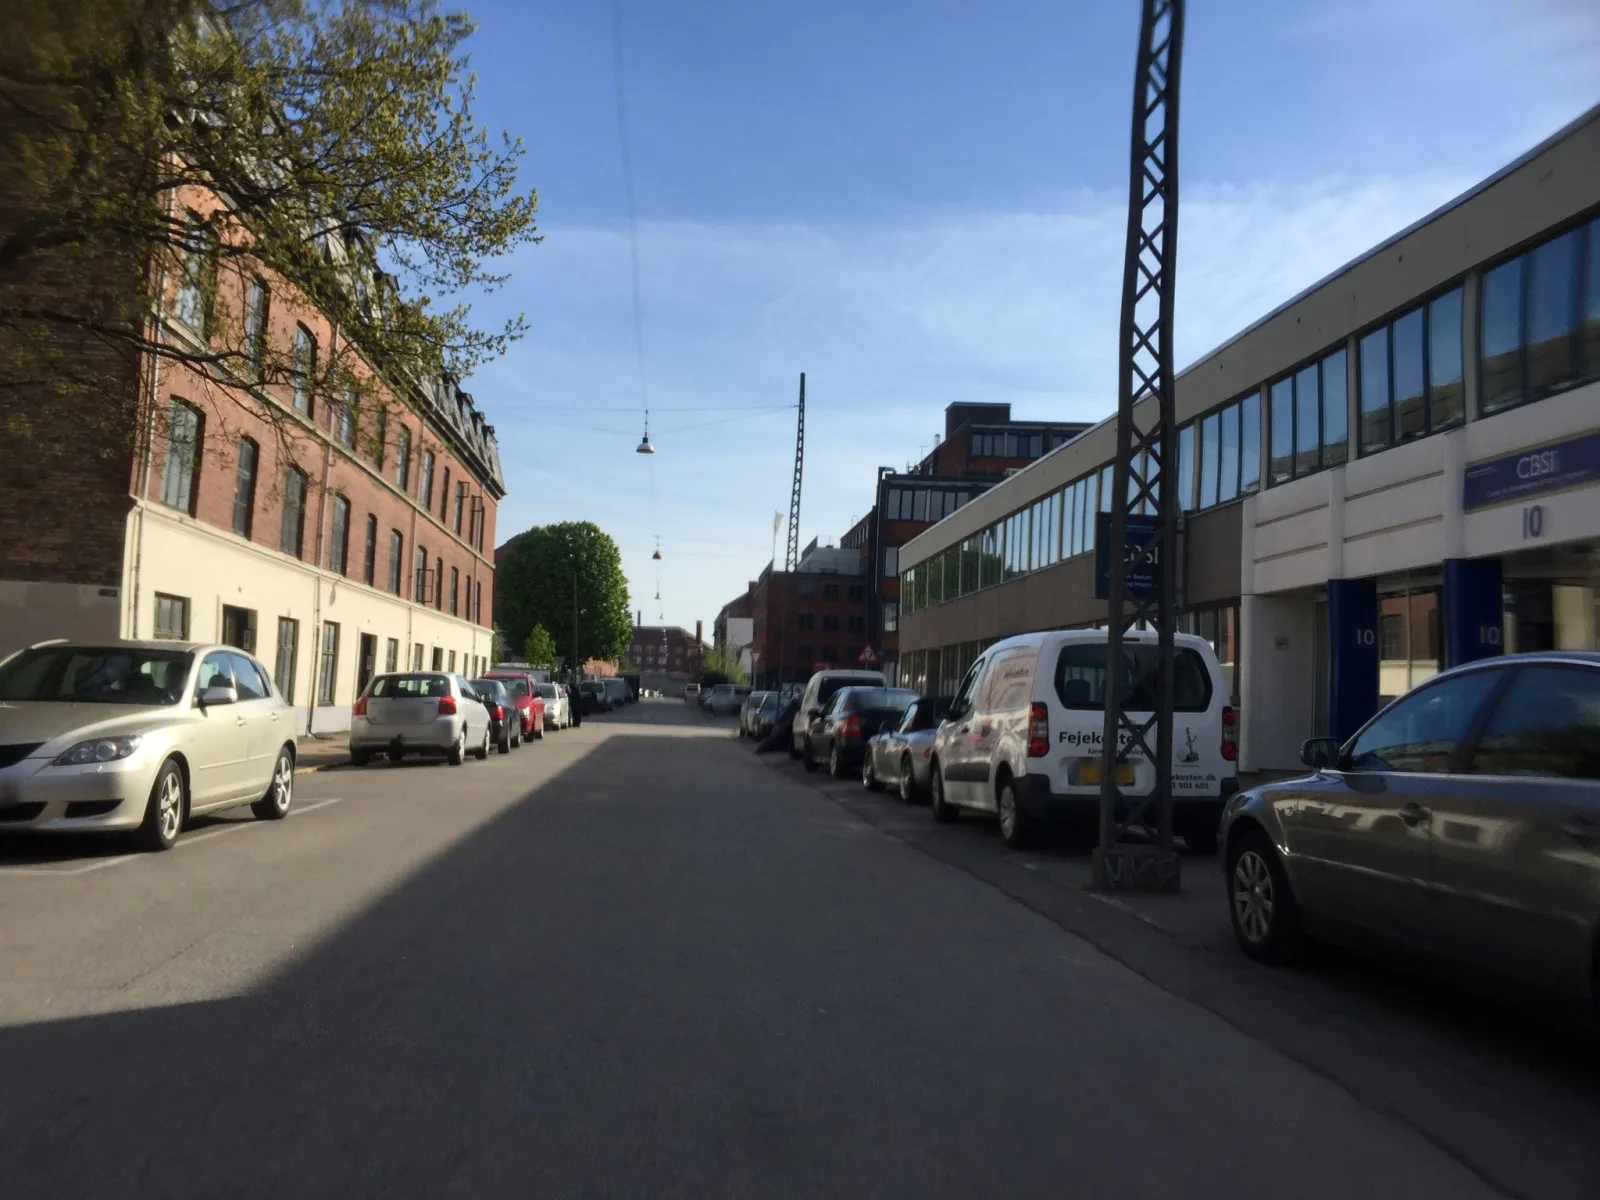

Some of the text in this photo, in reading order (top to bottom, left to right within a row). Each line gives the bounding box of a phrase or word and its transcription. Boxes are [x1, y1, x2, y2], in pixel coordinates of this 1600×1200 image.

[1522, 505, 1543, 540] 10
[1356, 628, 1375, 645] 10
[1480, 626, 1500, 645] 10
[1059, 731, 1143, 746] Fejekte
